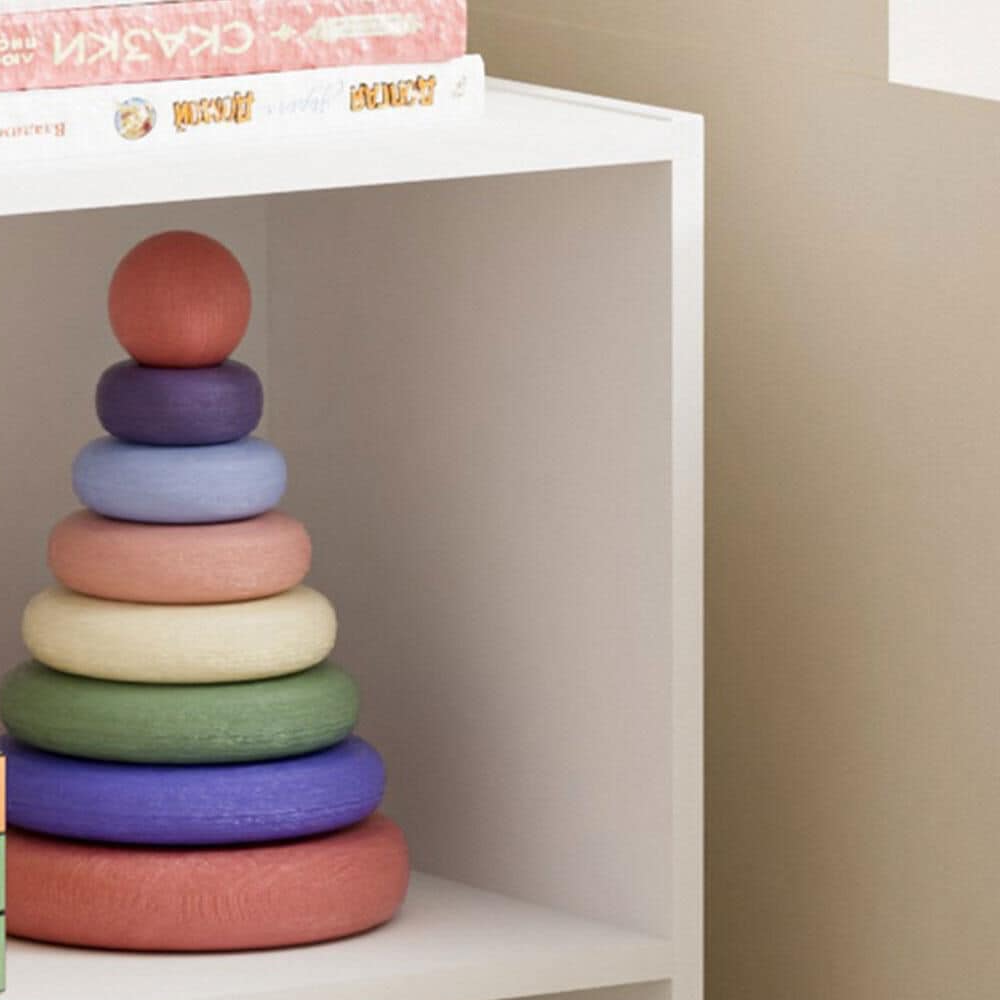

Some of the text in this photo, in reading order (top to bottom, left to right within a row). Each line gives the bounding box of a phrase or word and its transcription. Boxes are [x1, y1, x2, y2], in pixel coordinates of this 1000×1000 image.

[53, 21, 255, 65] СКАЗКИ
[173, 91, 255, 132] ДОМОЙ
[349, 75, 437, 111] ДОЛГАЯ
